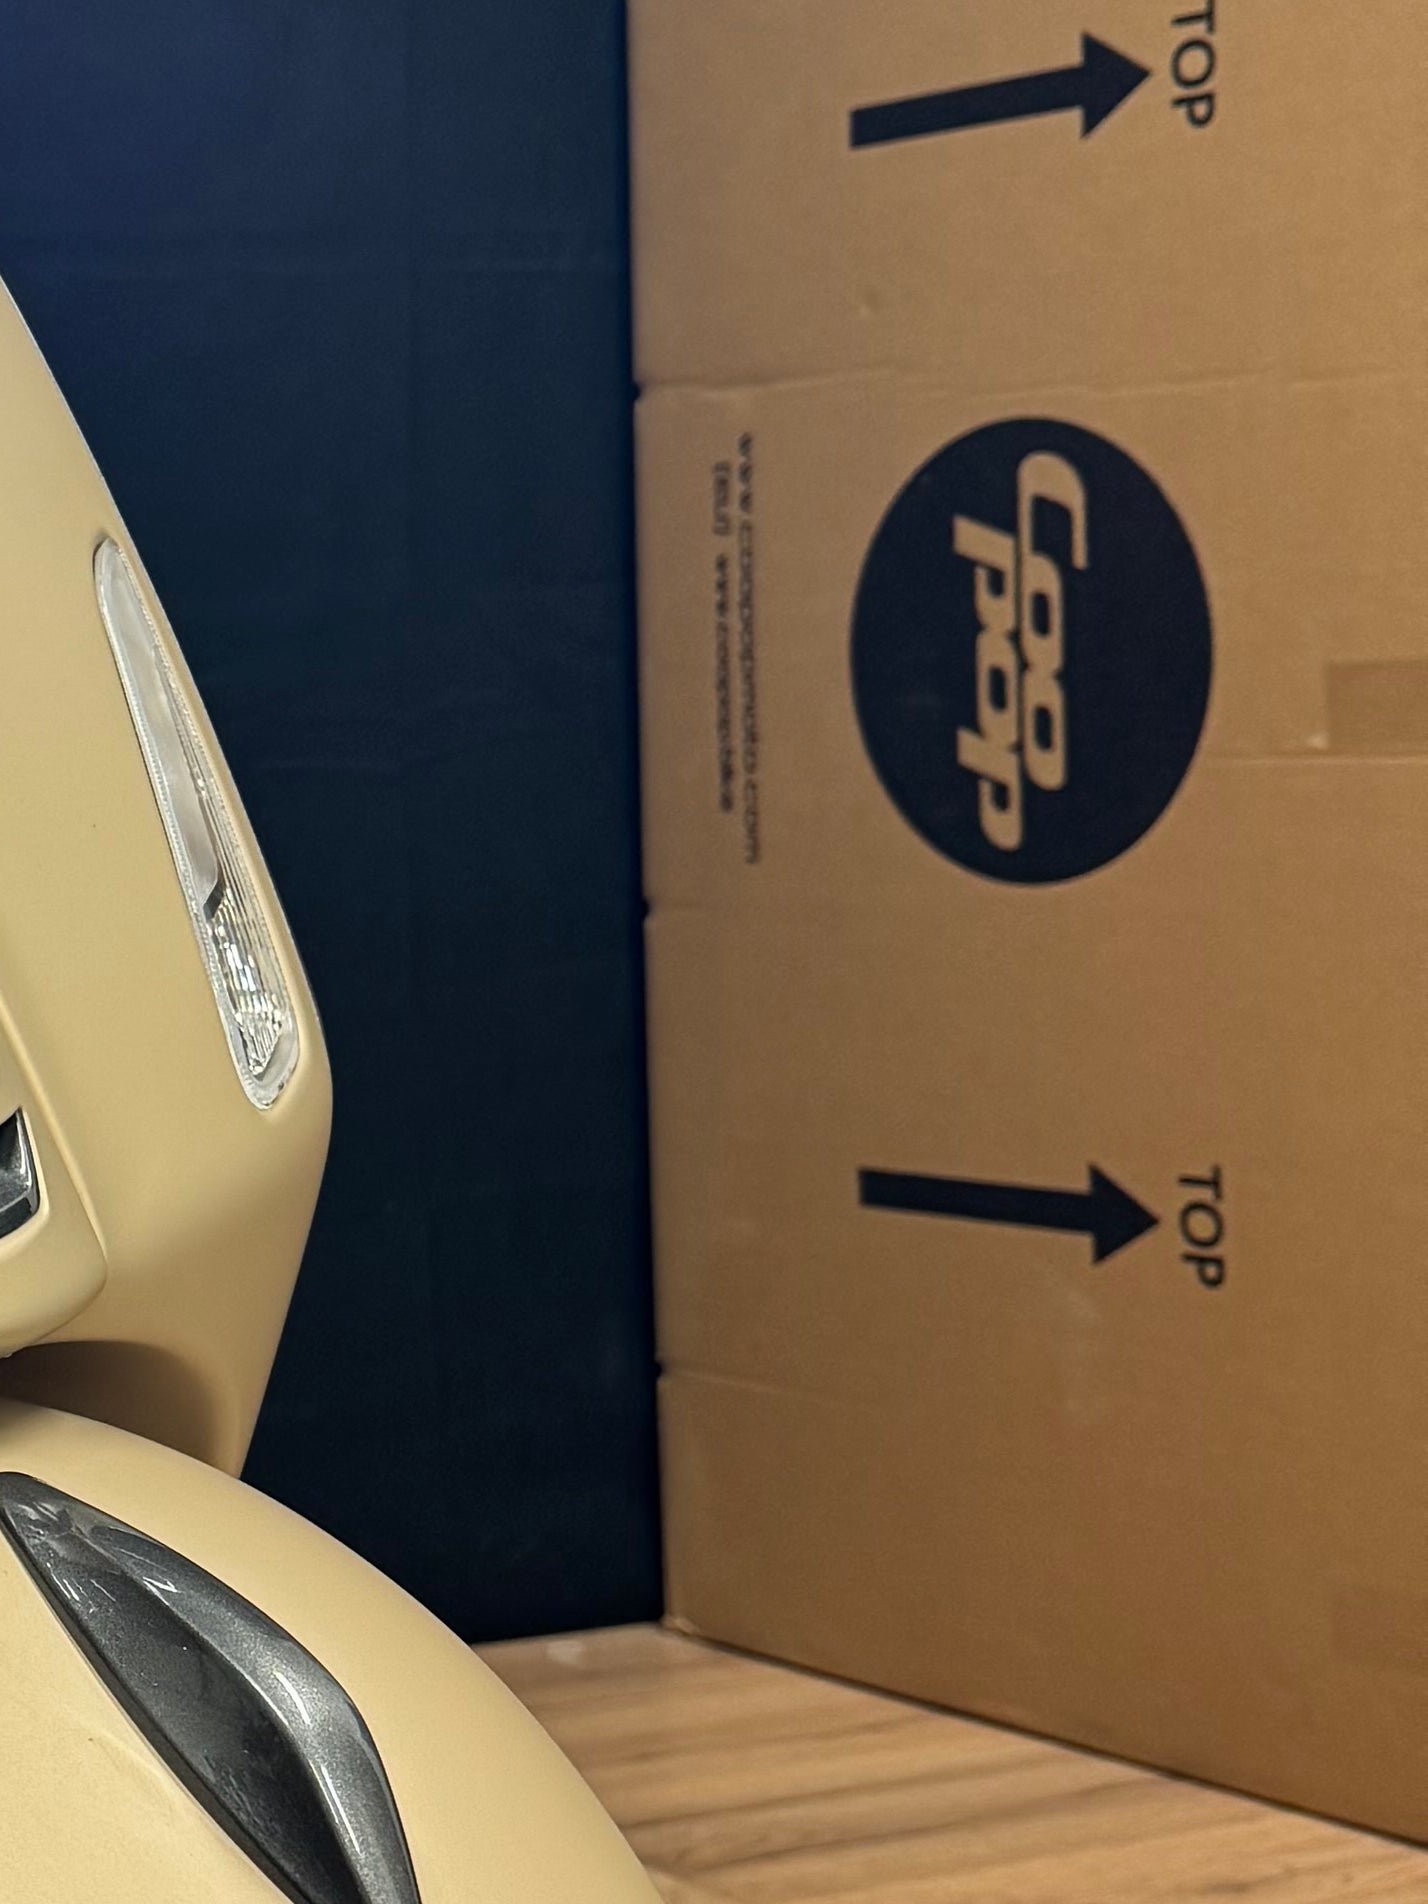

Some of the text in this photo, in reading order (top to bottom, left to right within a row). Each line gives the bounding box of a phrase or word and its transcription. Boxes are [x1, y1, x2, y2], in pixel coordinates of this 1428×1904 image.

[953, 514, 1022, 851] pop
[1017, 450, 1087, 791] Coo
[1178, 1165, 1224, 1289] TOP
